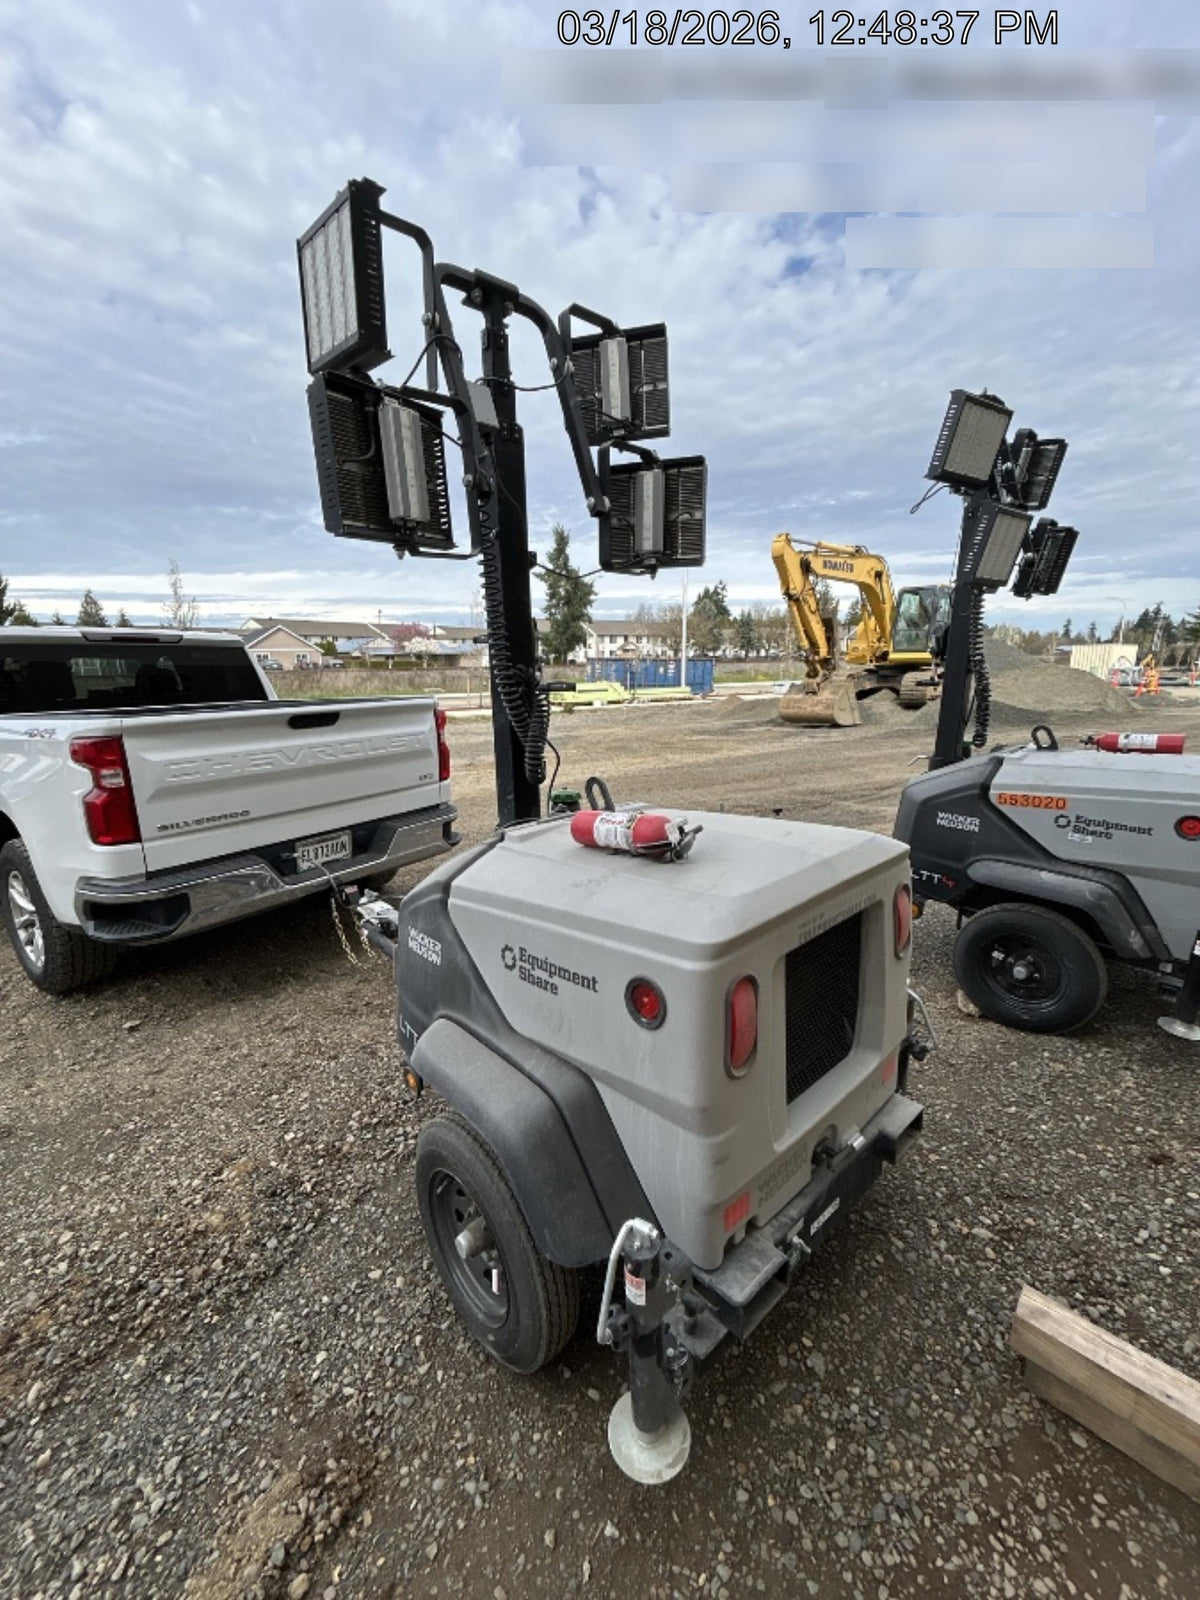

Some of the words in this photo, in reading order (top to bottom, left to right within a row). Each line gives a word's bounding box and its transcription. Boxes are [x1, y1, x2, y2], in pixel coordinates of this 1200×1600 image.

[822, 559, 854, 573] KOMATSU
[163, 731, 424, 783] CHEVROLET
[998, 793, 1066, 811] 553020
[156, 809, 251, 833] SILVERADO
[936, 818, 980, 832] NEUSON
[937, 811, 981, 826] WACKER
[1074, 814, 1154, 836] Equipment
[1072, 824, 1114, 840] Share
[408, 925, 442, 951] WACKER
[408, 936, 442, 966] NEUSON
[518, 946, 599, 994] Equipment
[518, 966, 559, 997] Share
